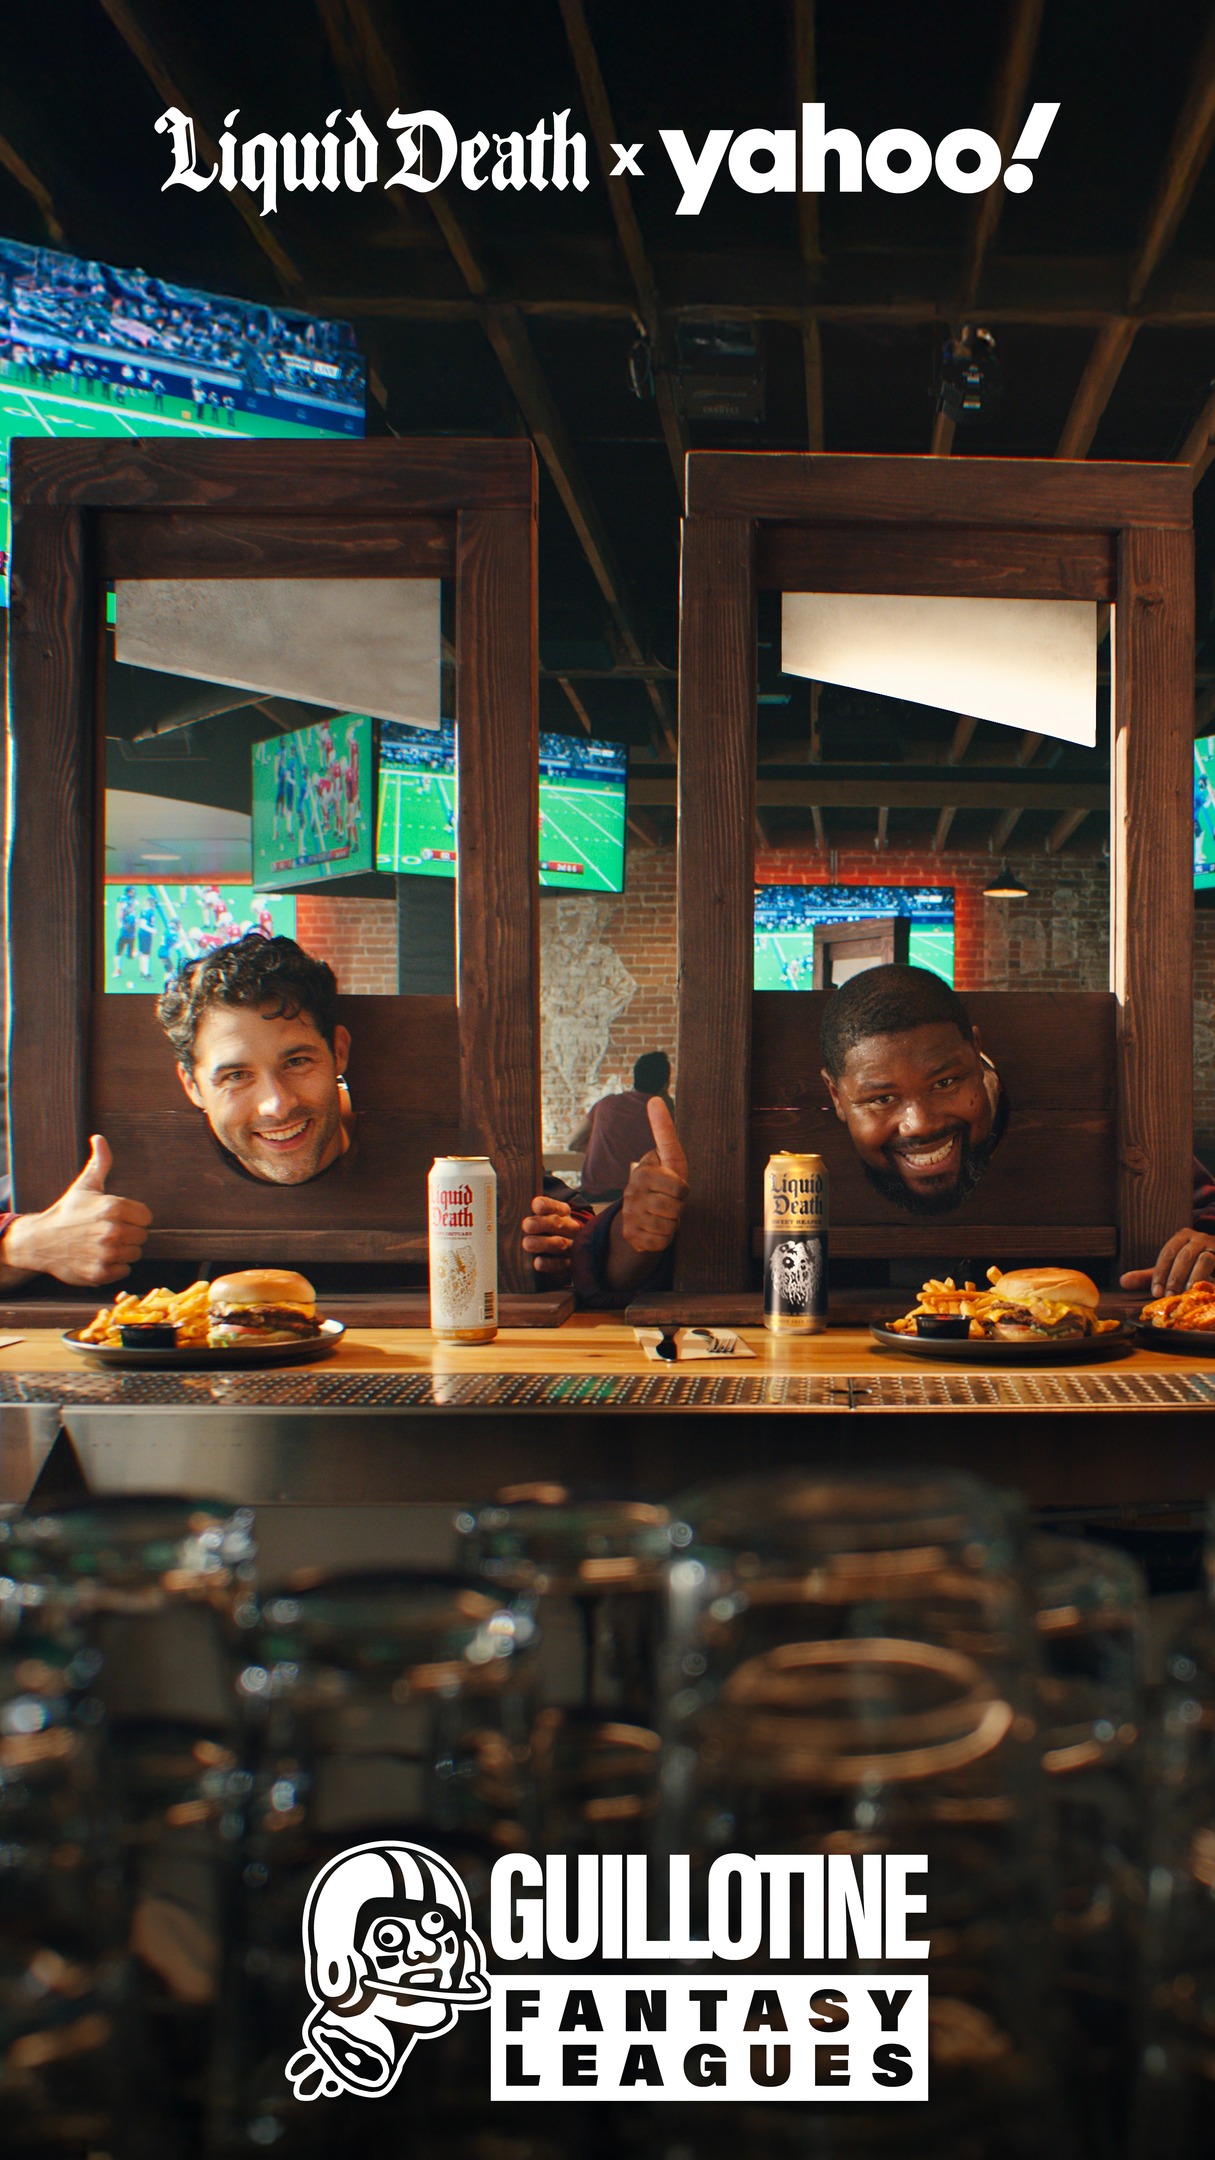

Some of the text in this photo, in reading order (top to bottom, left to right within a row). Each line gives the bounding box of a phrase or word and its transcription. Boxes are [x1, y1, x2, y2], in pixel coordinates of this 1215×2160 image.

[770, 1173, 822, 1198] Liquid
[773, 1194, 822, 1215] Death
[432, 1206, 473, 1228] Death
